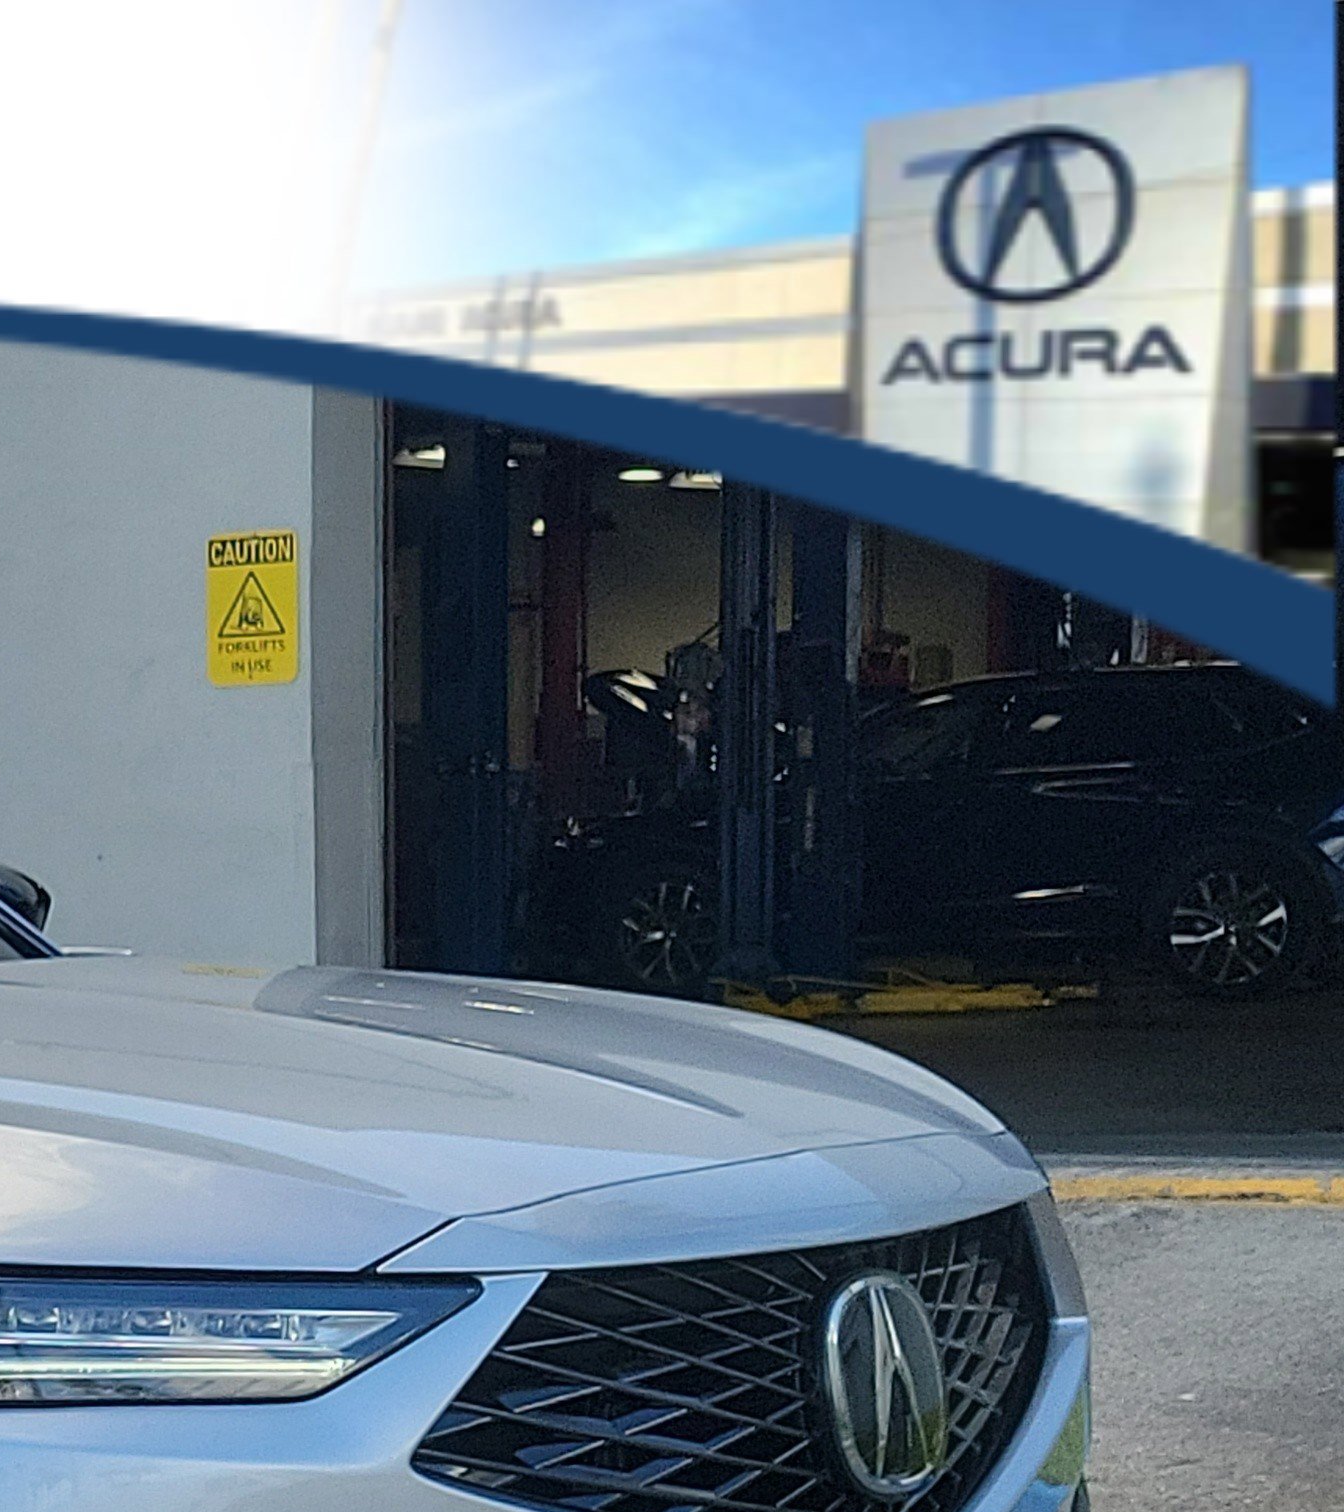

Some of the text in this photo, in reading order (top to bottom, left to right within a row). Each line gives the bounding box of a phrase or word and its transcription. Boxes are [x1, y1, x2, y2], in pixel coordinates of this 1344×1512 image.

[211, 536, 291, 566] CAUTION
[218, 639, 286, 655] FORKLIFTS
[231, 660, 246, 673] IN
